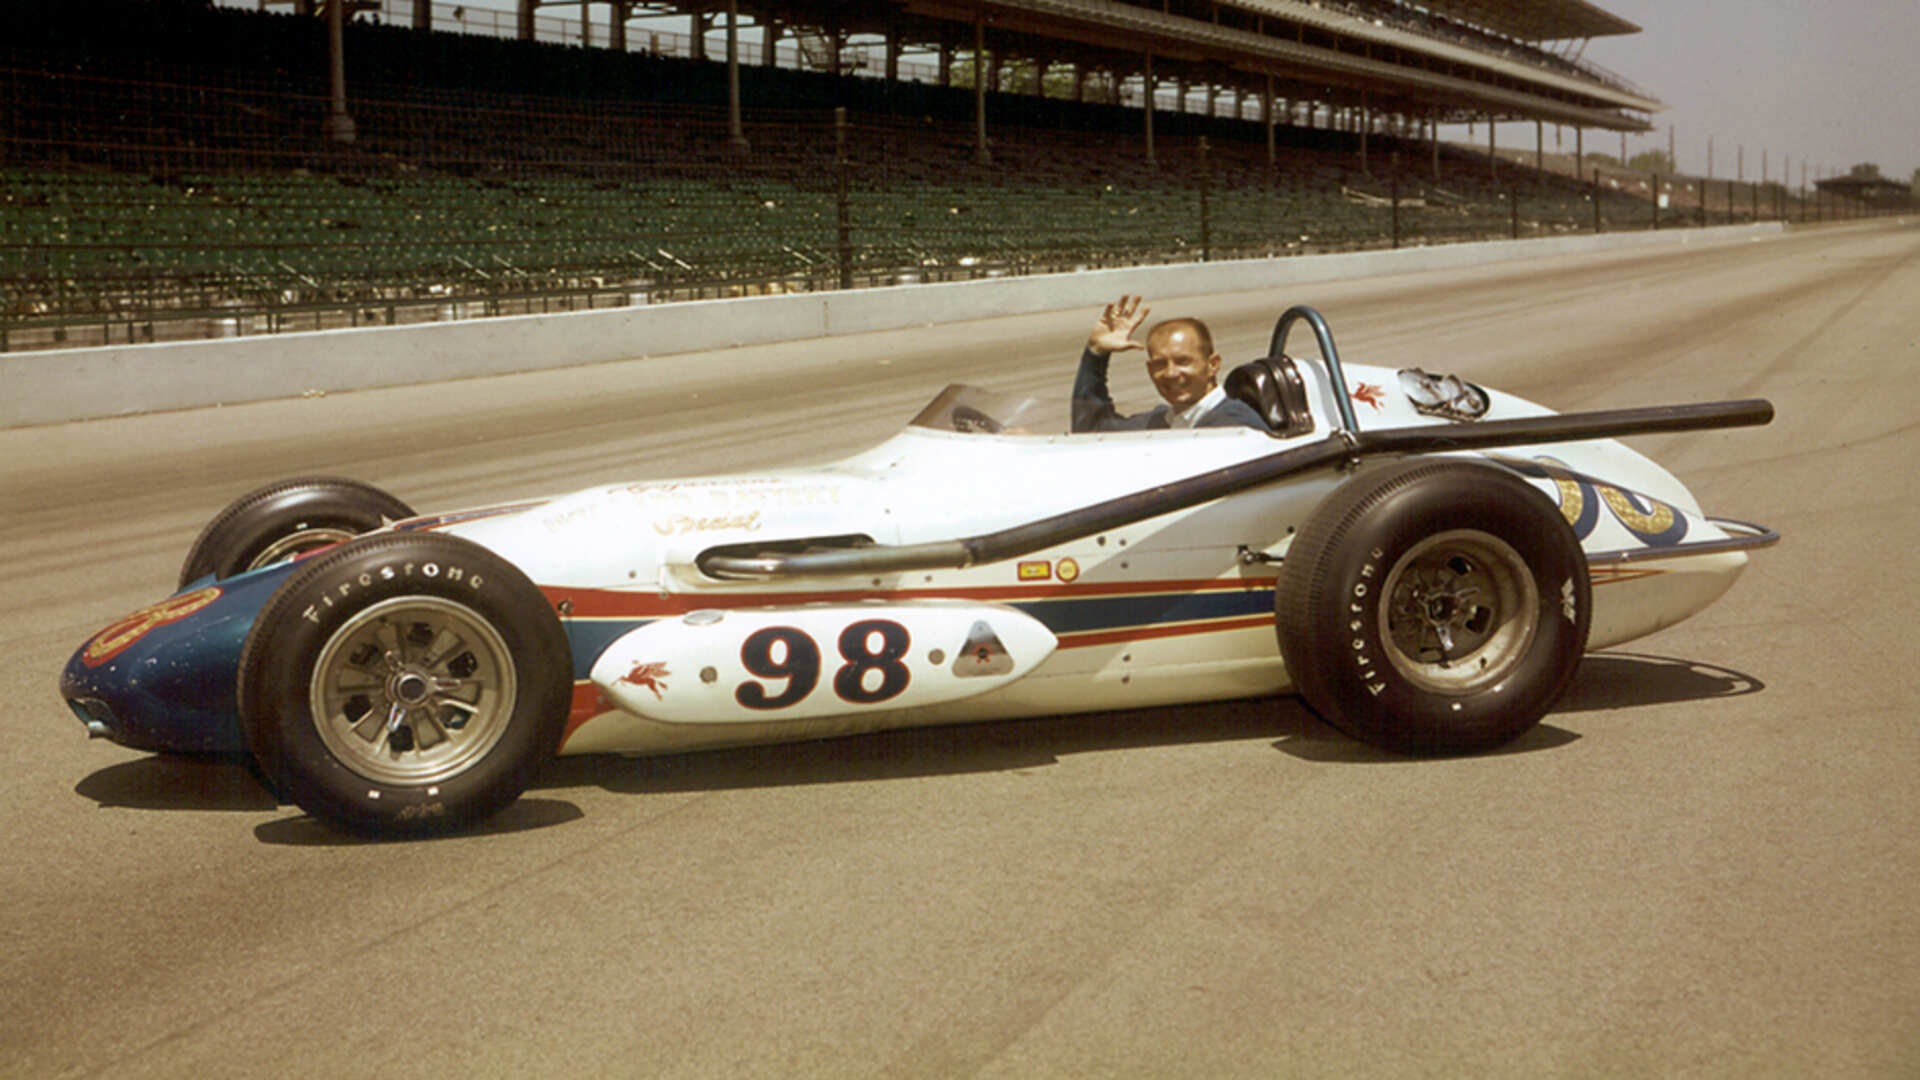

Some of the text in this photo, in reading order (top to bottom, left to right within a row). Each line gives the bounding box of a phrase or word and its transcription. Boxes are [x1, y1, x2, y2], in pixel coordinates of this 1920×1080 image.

[653, 509, 761, 537] Special
[303, 561, 484, 625] Firestone
[735, 618, 911, 711] 98
